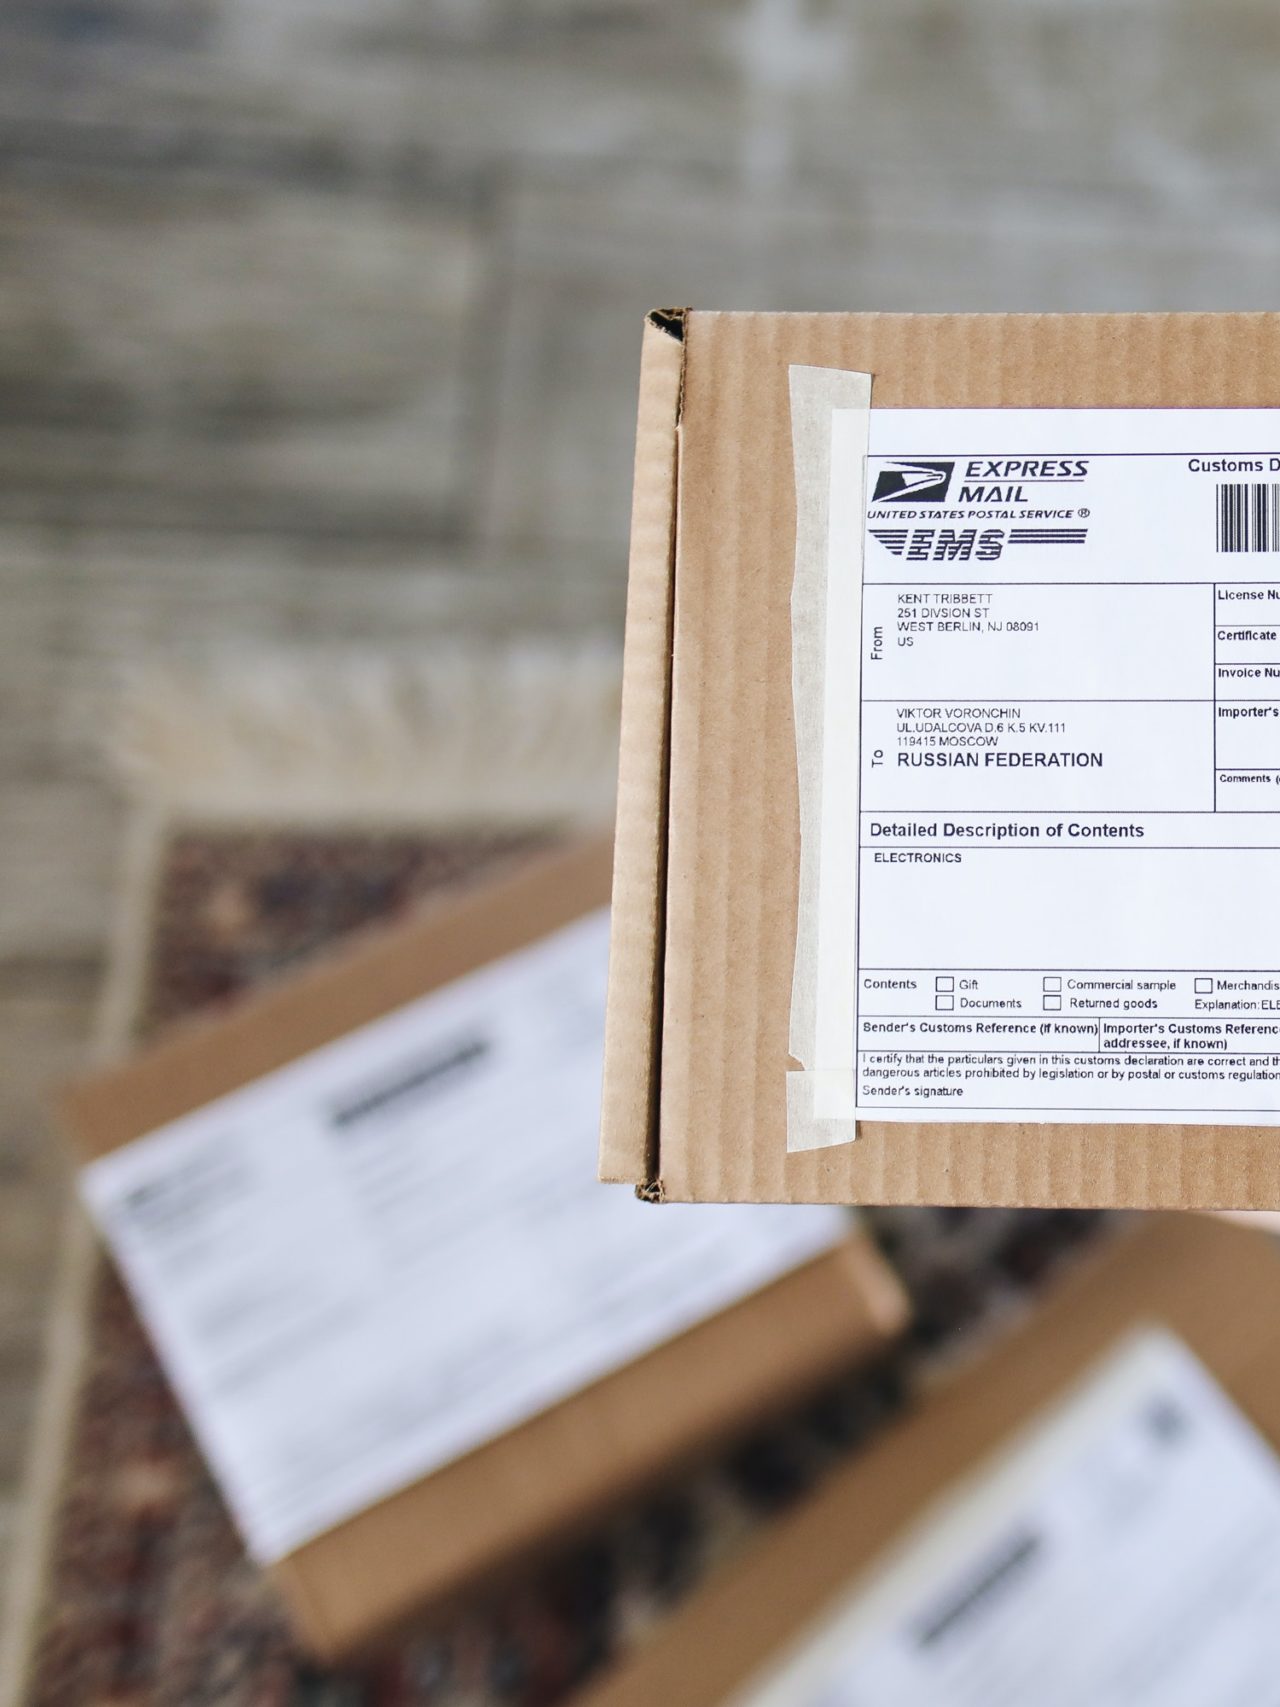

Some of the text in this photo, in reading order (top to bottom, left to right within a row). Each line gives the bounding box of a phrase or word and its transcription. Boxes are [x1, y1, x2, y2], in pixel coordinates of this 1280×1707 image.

[965, 460, 1089, 477] EXPRESS
[1187, 458, 1263, 472] Customs
[957, 485, 1028, 503] MAIL
[867, 509, 1074, 519] UNITED STATES POSTAL SERVICE
[905, 528, 1005, 561] EMS
[897, 593, 992, 604] KENT TRIBBETT
[1217, 589, 1264, 600] License
[897, 607, 916, 618] 251
[973, 607, 990, 618] ST
[897, 621, 1038, 633] WEST BERLIN, NJ 08091
[1217, 629, 1277, 641] Certificate
[870, 626, 883, 660] From
[897, 636, 914, 647] US
[1217, 667, 1261, 678] Invoice
[896, 707, 1021, 719] VIKTOR VORONCHIN
[1217, 706, 1279, 719] Importer's
[984, 722, 1004, 733] D.6
[1007, 722, 1026, 733] K.5
[1029, 722, 1065, 733] KV.111
[897, 735, 999, 746] 119415 MOSCOW
[871, 749, 884, 768] To
[897, 752, 1103, 767] RUSSIAN FEDERATION
[870, 822, 1144, 840] Detailed Description of Contents
[874, 852, 962, 863] ELECTRONICS
[863, 978, 917, 989] Contents
[959, 979, 978, 990] Gift
[1067, 978, 1176, 992] Commercial sample
[959, 997, 1022, 1008] Documents
[1069, 997, 1158, 1010] Returned goods
[863, 1021, 1099, 1035] Sender's Customs Reference known)
[1103, 1023, 1165, 1035] Importer's
[1167, 1023, 1222, 1034] Customs
[1103, 1037, 1227, 1050] addressee, if known)
[862, 1066, 920, 1079] dangerous
[923, 1067, 962, 1078] articles
[964, 1065, 1019, 1079] prohibited
[1022, 1067, 1036, 1080] by
[1038, 1067, 1094, 1080] legislation
[1097, 1070, 1109, 1079] or
[1111, 1068, 1125, 1081] by
[1127, 1068, 1161, 1081] postal
[1163, 1071, 1175, 1079] or
[1178, 1069, 1225, 1080] customs
[862, 1085, 963, 1098] Sender's signature
